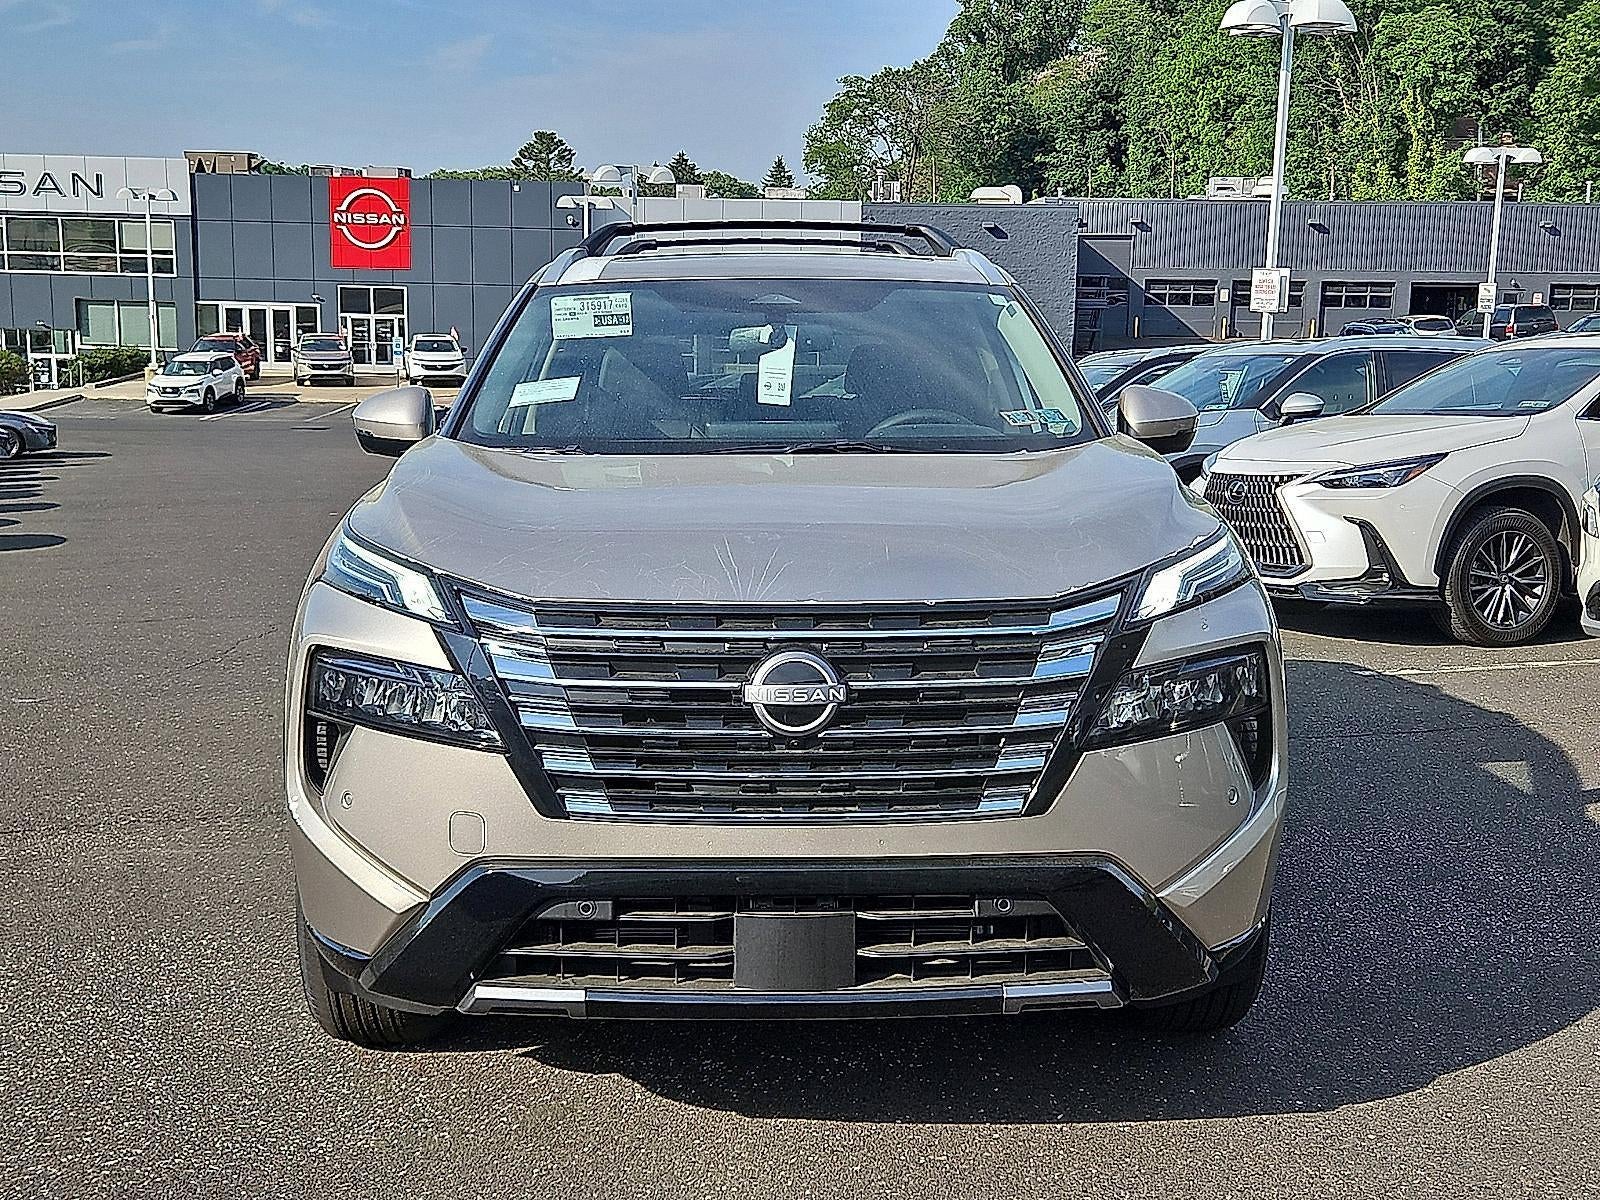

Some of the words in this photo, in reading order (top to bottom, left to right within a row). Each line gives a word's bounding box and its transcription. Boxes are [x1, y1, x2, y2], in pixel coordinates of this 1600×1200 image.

[0, 171, 104, 198] SAN
[333, 212, 405, 225] NISSAN
[579, 299, 613, 311] 315917
[746, 687, 844, 702] NISSAN
